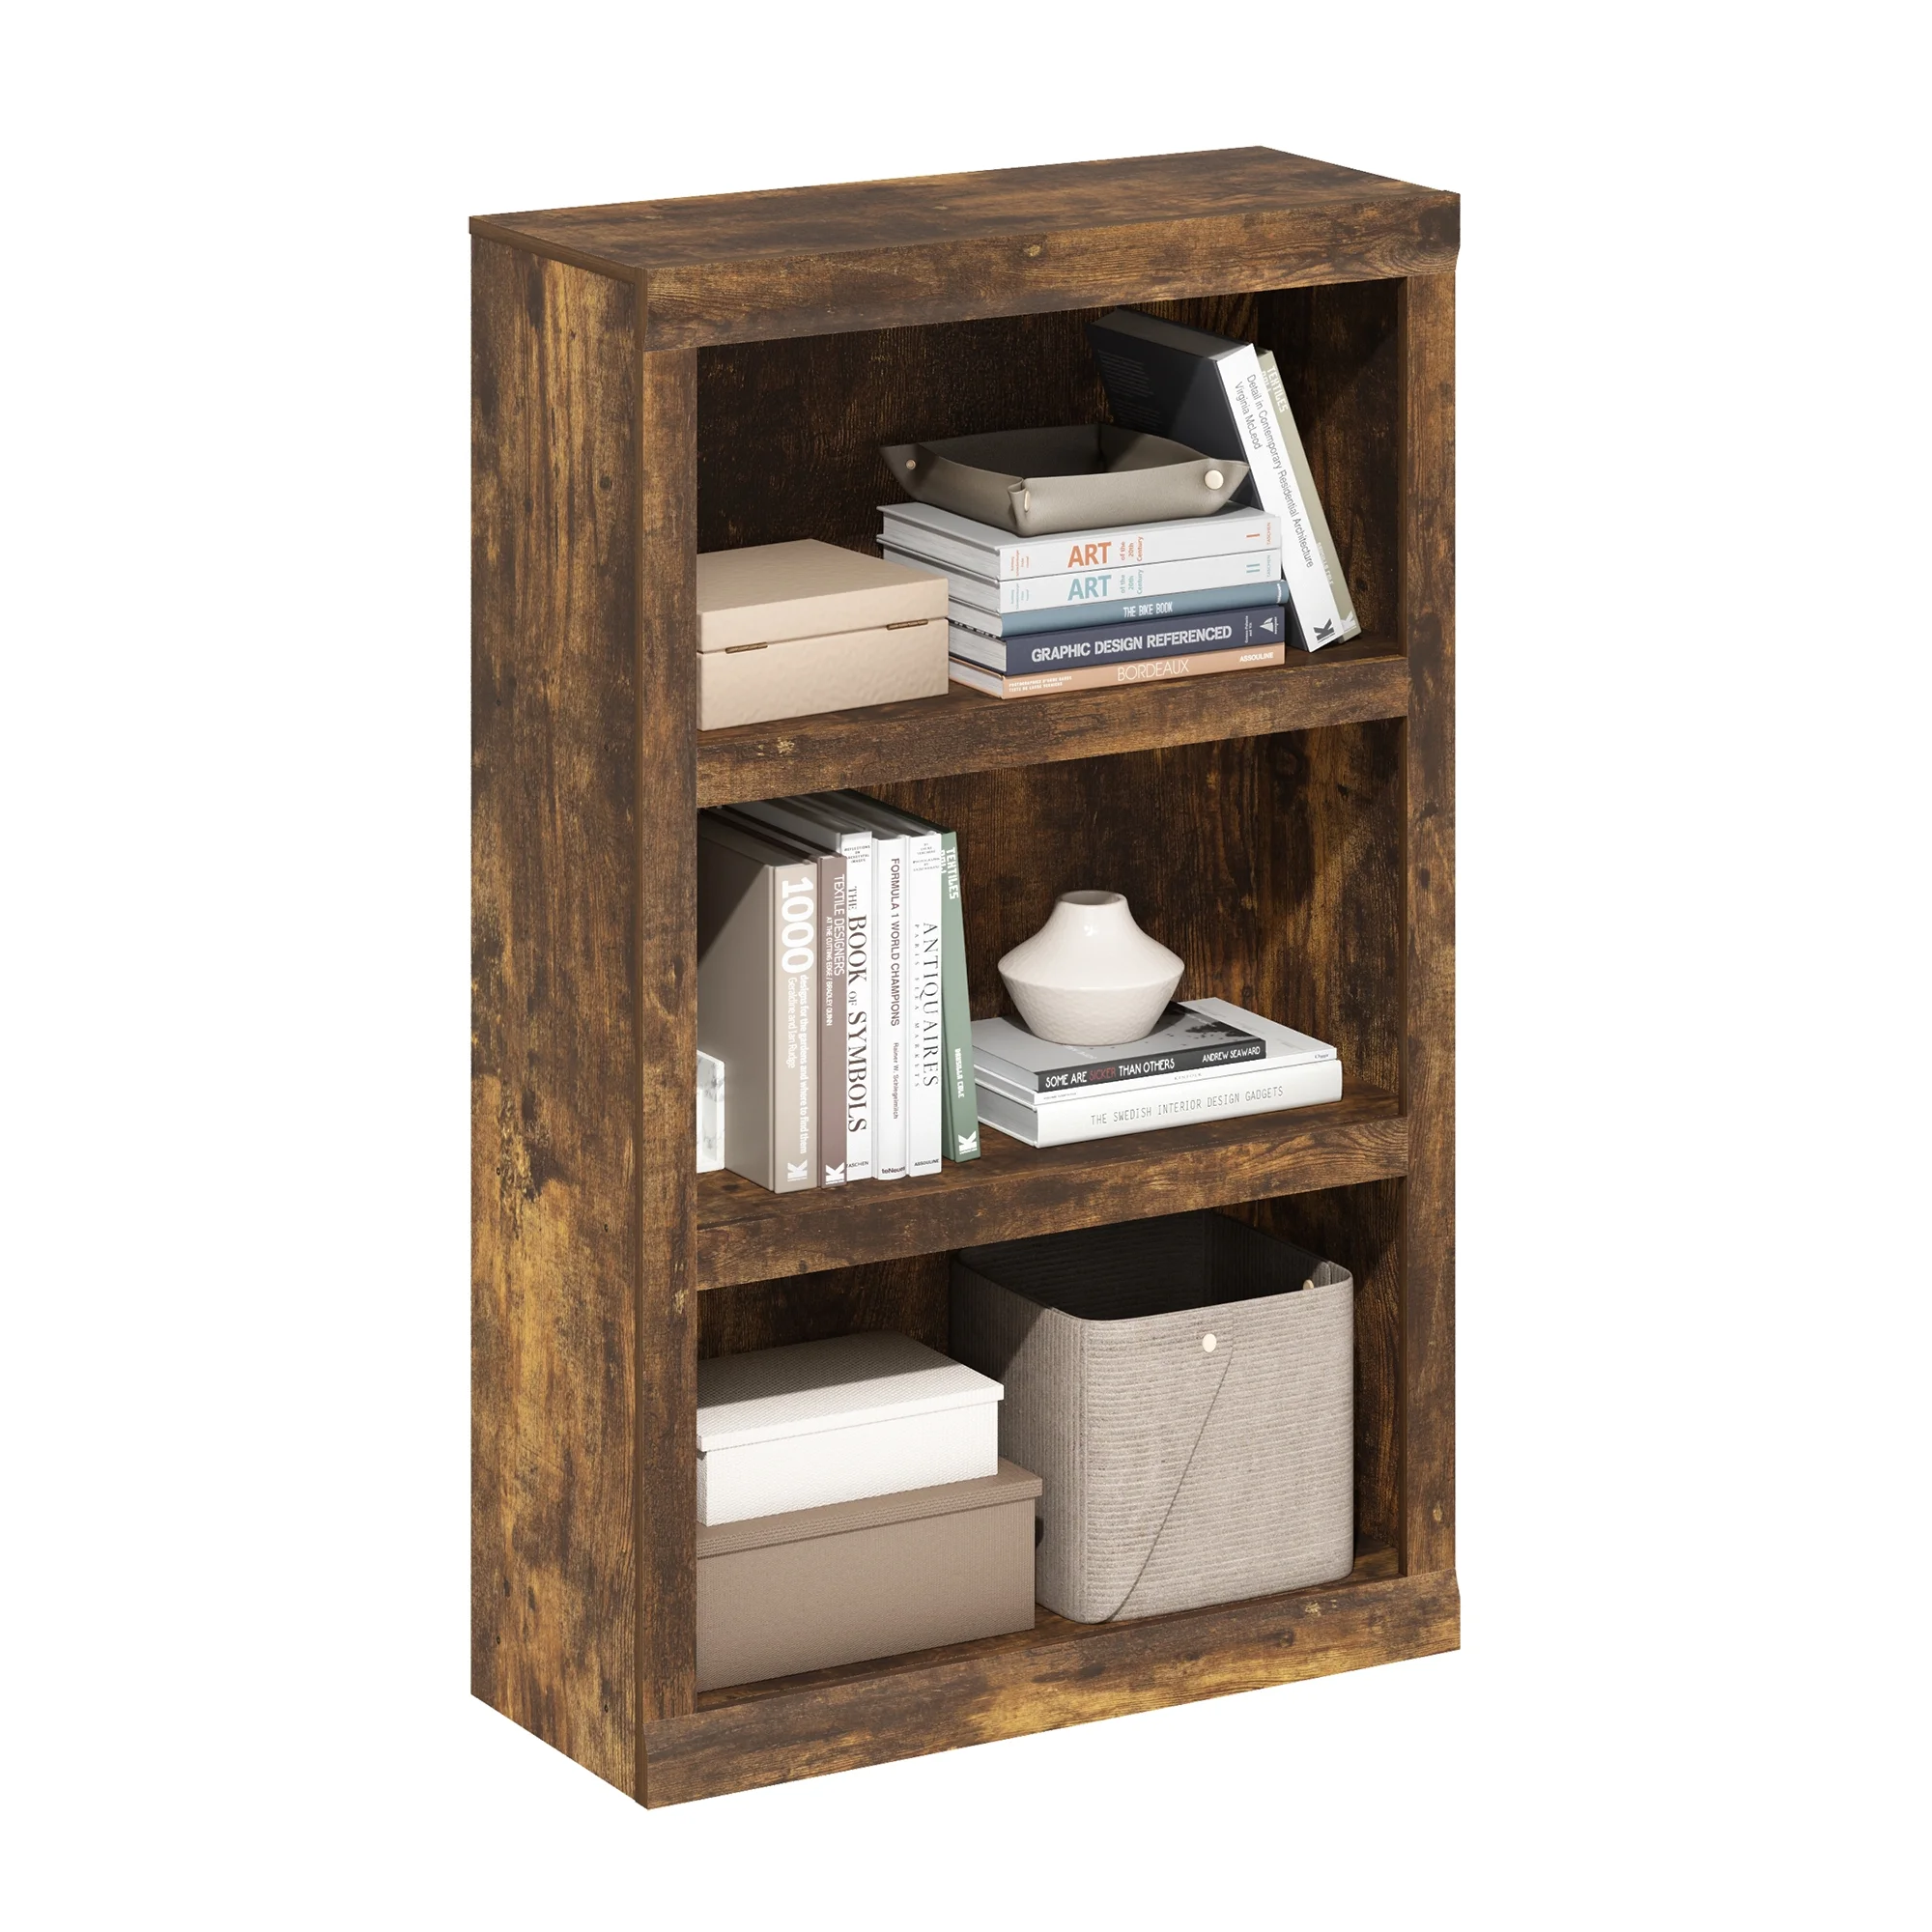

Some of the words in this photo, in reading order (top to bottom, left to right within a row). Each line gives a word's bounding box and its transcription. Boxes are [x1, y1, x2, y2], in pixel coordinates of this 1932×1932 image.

[1246, 374, 1263, 401] Detail
[1235, 381, 1250, 415] Virginia
[1245, 414, 1263, 449] McLeod
[1256, 400, 1264, 411] in
[1258, 410, 1283, 469] Contemporary
[1277, 469, 1298, 518] Residential
[1067, 541, 1112, 568] ART
[1136, 536, 1145, 562] Century
[1293, 517, 1315, 568] Architecture
[1067, 575, 1112, 601] ART
[1136, 569, 1145, 595] Century
[1122, 606, 1137, 618] THE
[1138, 603, 1153, 616] BIKE
[1155, 601, 1174, 614] BOOK
[1031, 641, 1092, 663] GRAPHIC
[1094, 636, 1143, 655] DESIGN
[1147, 625, 1233, 649] REFERENCED
[1239, 651, 1275, 663] ASSOULINE
[1117, 659, 1189, 682] BORDEAUX
[834, 873, 845, 916] TEXTILE
[891, 858, 900, 910] FORMULA
[848, 886, 857, 910] THE
[781, 876, 814, 974] 1000
[834, 918, 845, 976] DESIGNERS
[848, 915, 867, 985] BOOK
[891, 921, 900, 960] WORLD
[787, 977, 798, 1013] Geraldine
[798, 974, 810, 1005] designs
[848, 991, 857, 1006] OF
[891, 963, 900, 1027] CHAMPIONS
[800, 1005, 810, 1017] for
[920, 923, 939, 1087] ANTIQUAIRES
[787, 1014, 798, 1029] and
[800, 1018, 809, 1032] the
[785, 1045, 798, 1068] Rudge
[798, 1033, 810, 1065] gardens
[1202, 1049, 1229, 1063] ANDREW
[1230, 1046, 1261, 1058] SEAWARD
[800, 1065, 809, 1080] and
[848, 1011, 867, 1132] SYMBOLS
[1045, 1073, 1068, 1089] SOME
[1070, 1071, 1088, 1084] ARE
[1089, 1066, 1117, 1081] SICKER
[1119, 1064, 1142, 1077] THAN
[1143, 1058, 1176, 1073] OTHERS
[800, 1081, 810, 1105] where
[1091, 1114, 1107, 1125] THE
[1113, 1107, 1152, 1122] SWEDISH
[1158, 1098, 1202, 1116] INTERIOR
[1208, 1093, 1240, 1108] DESIGN
[1245, 1086, 1284, 1101] GADGETS
[800, 1106, 809, 1116] to
[800, 1116, 810, 1132] find
[800, 1133, 810, 1154] them
[914, 1158, 940, 1167] ASSOULINE
